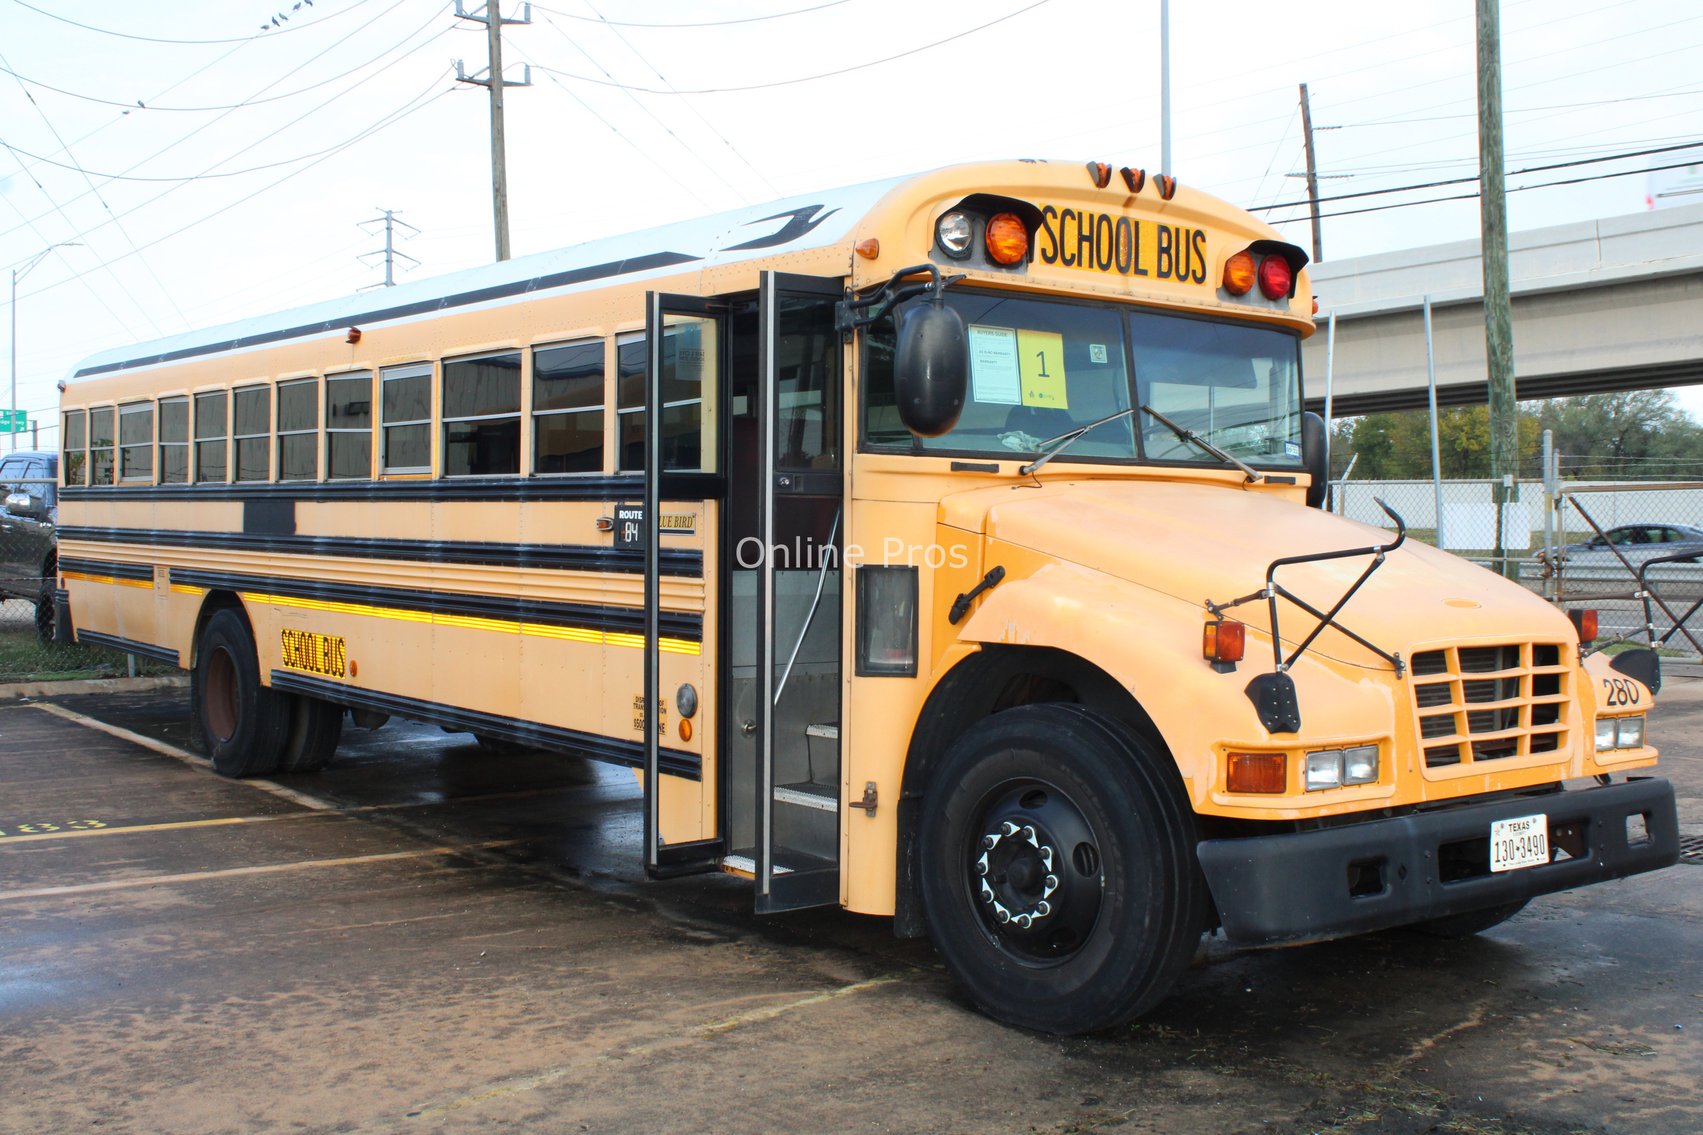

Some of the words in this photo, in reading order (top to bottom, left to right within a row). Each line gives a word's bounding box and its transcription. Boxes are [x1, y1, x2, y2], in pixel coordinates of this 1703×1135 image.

[1041, 205, 1148, 276] SCHOOL
[1157, 224, 1207, 284] BUS
[1036, 351, 1050, 377] 1
[619, 510, 643, 520] ROUTE
[659, 516, 672, 528] LUE
[674, 516, 693, 528] BIRD
[625, 521, 638, 543] 84
[282, 629, 321, 672] SCHOOL
[323, 636, 345, 678] BUS
[1603, 679, 1639, 706] 280
[1509, 821, 1530, 832] TEXAS
